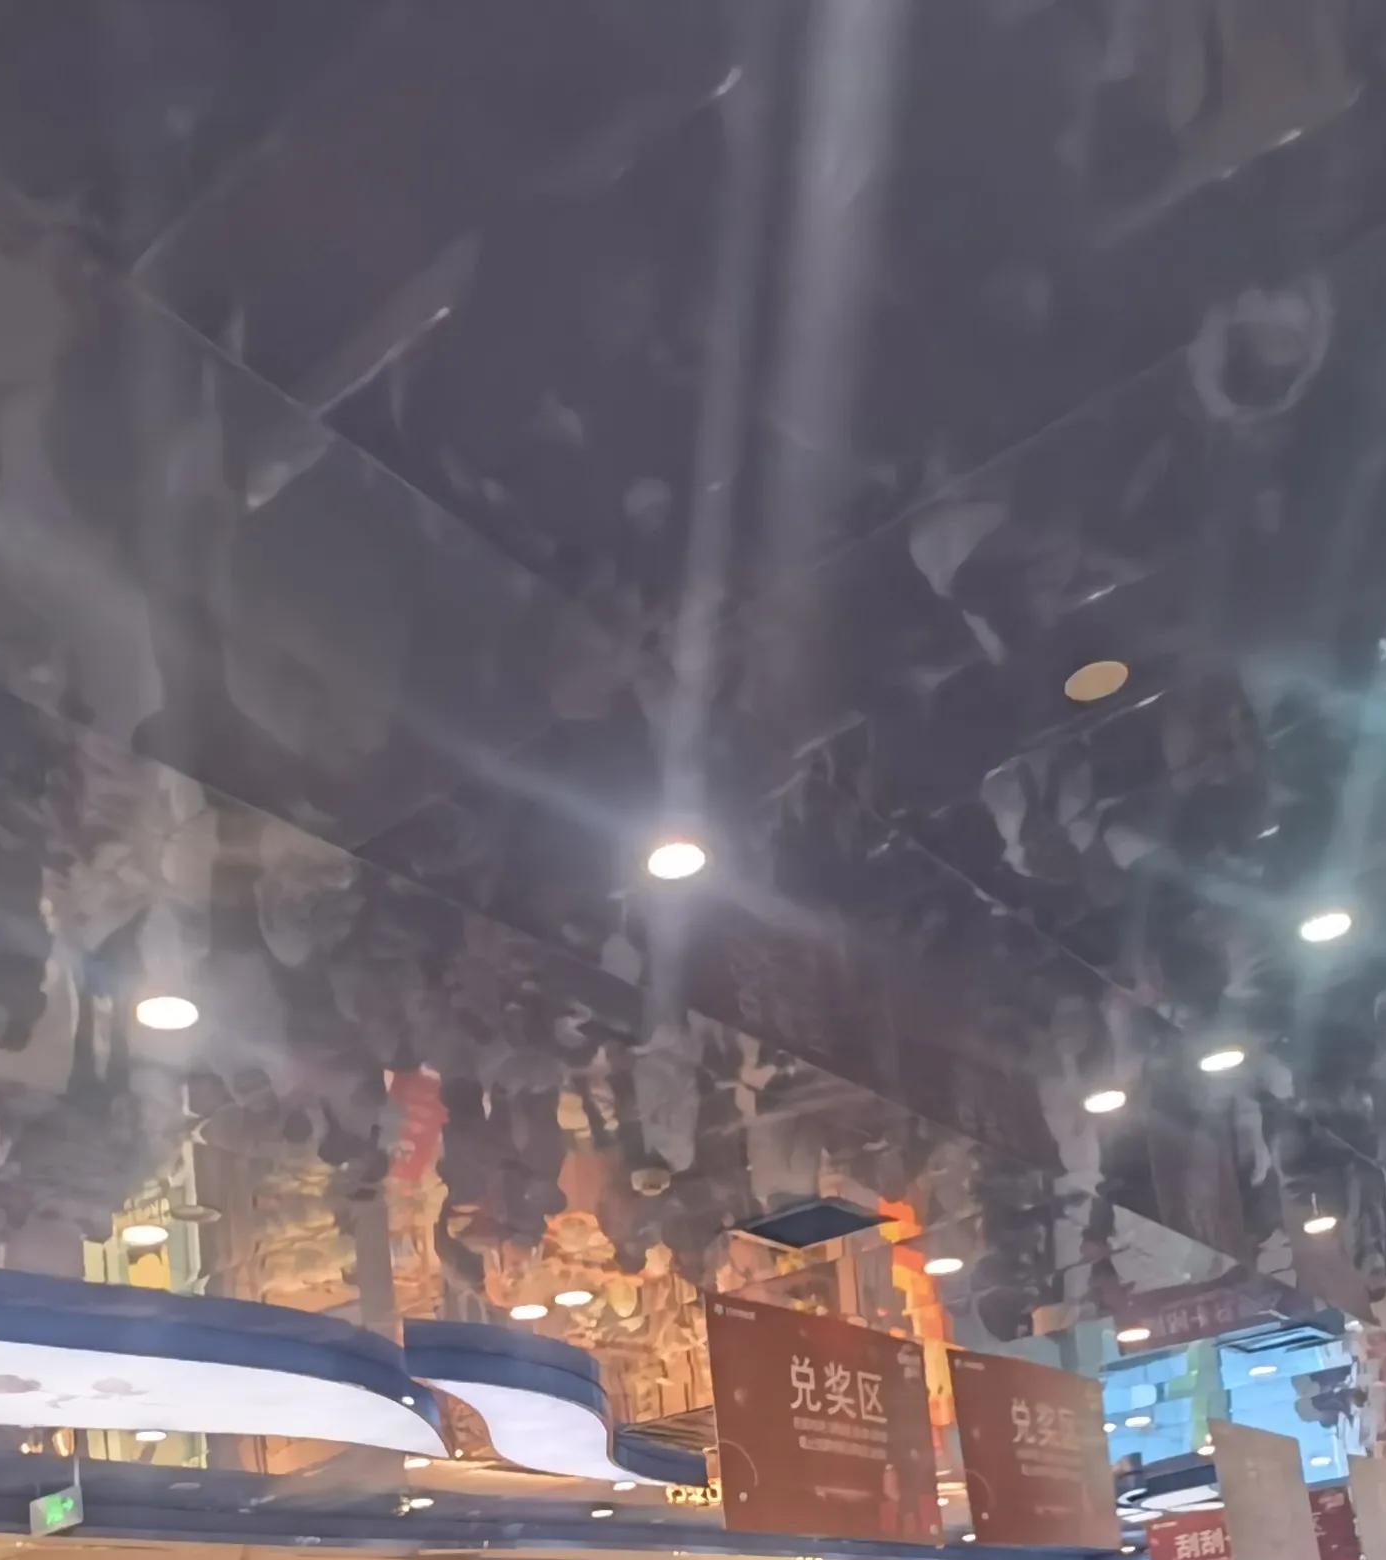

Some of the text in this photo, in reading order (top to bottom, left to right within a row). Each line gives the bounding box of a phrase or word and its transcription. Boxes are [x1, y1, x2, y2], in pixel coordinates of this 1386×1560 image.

[790, 1355, 887, 1421] 兑奖区
[1173, 1527, 1232, 1560] 刮刮
